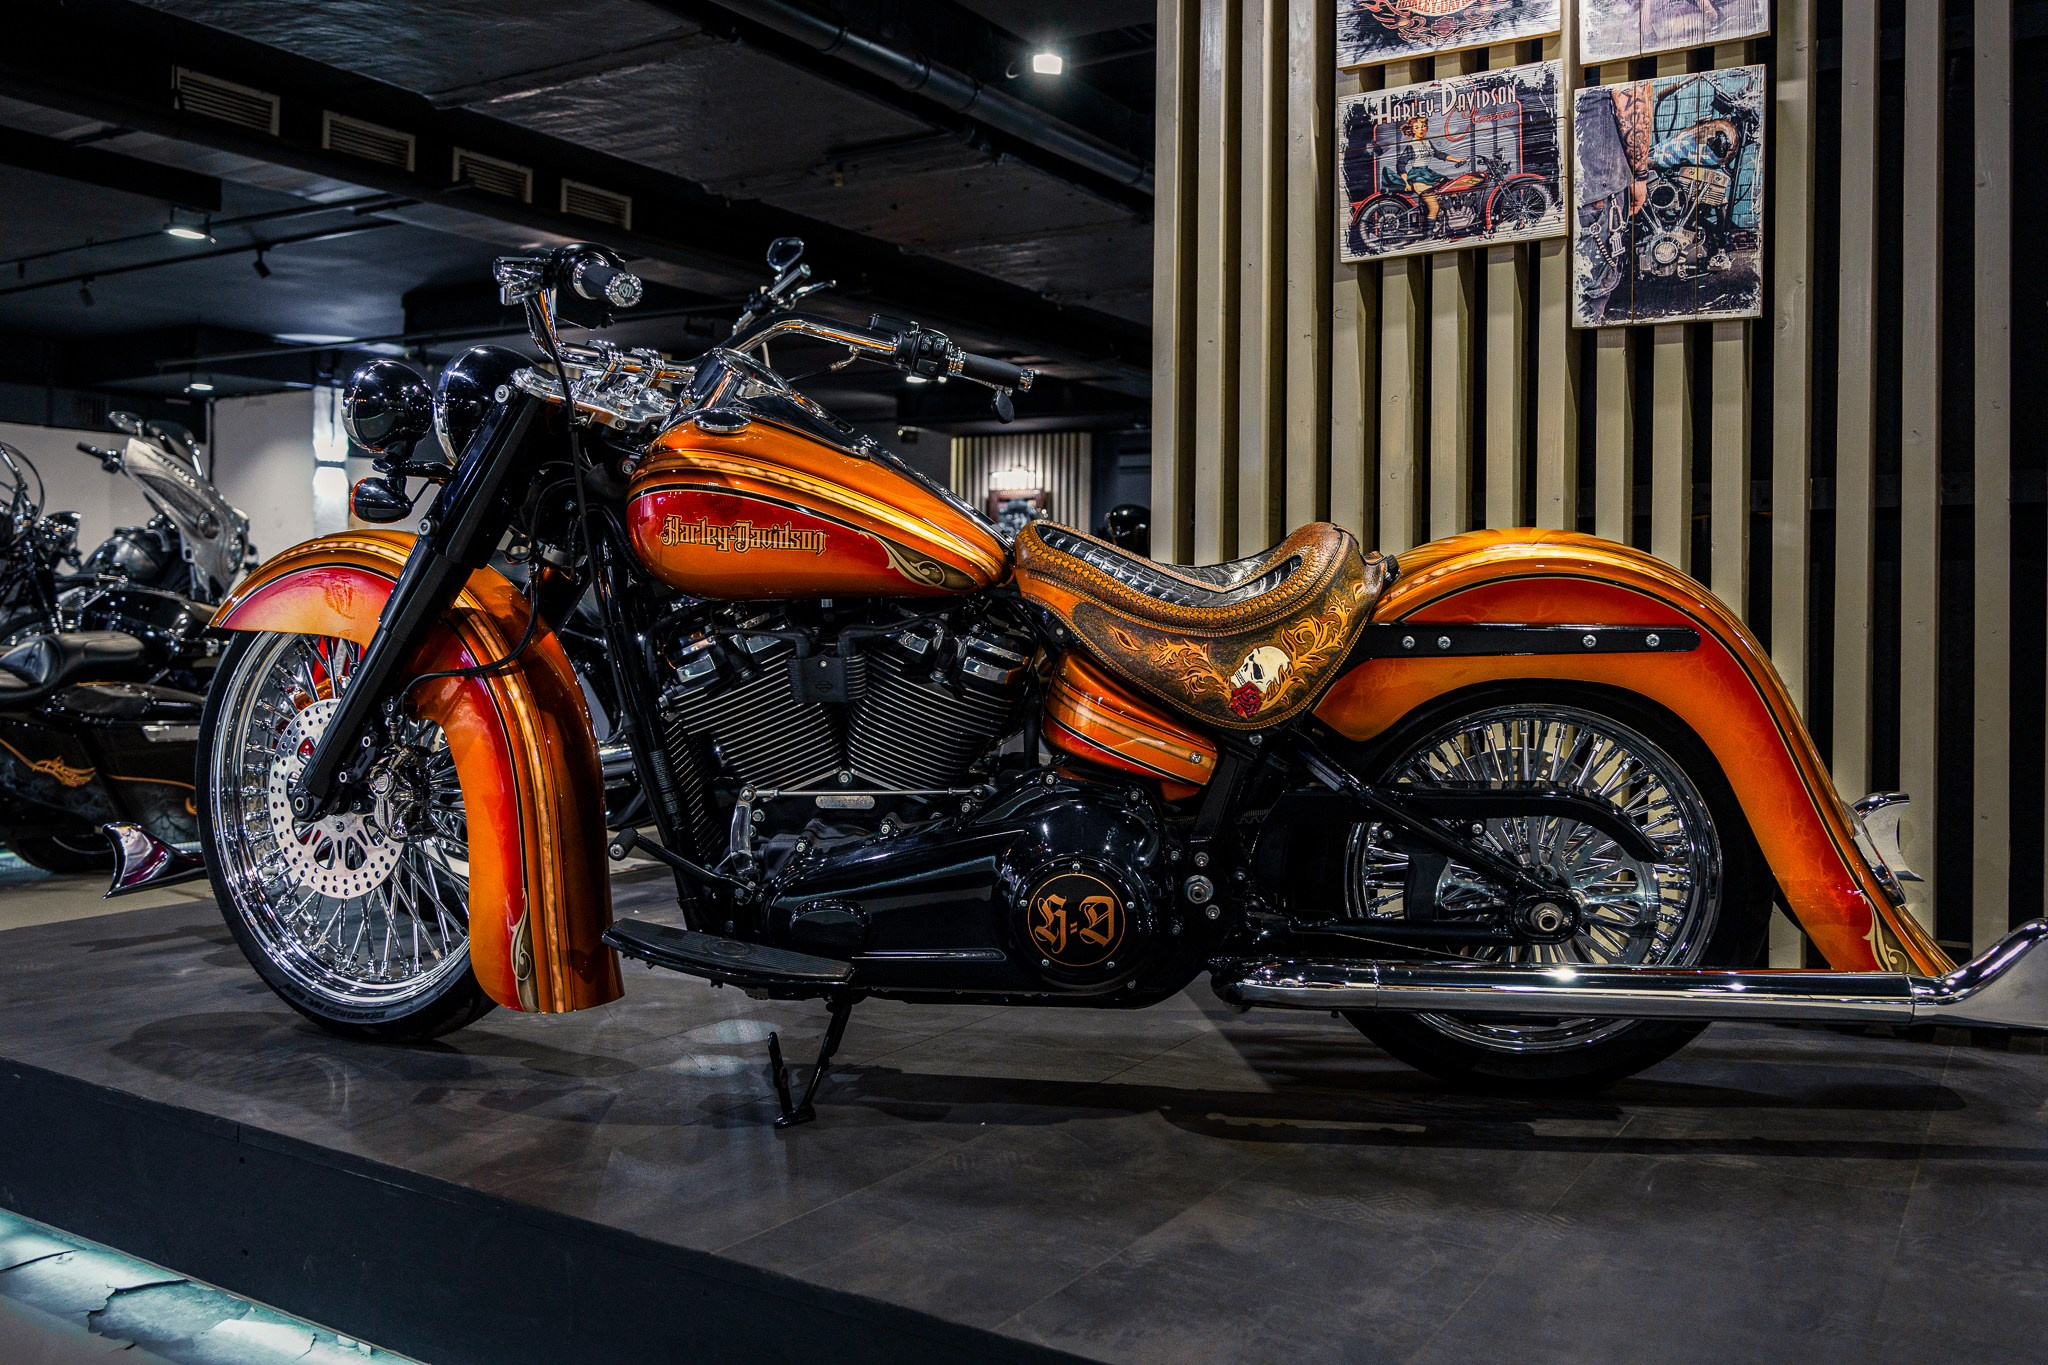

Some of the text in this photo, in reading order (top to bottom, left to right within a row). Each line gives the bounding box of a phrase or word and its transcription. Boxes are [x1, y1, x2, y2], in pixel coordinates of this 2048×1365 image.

[1371, 83, 1516, 126] HARLEY-DAVIDSON
[1444, 105, 1516, 142] Classic
[660, 514, 827, 556] Harley-Davidson
